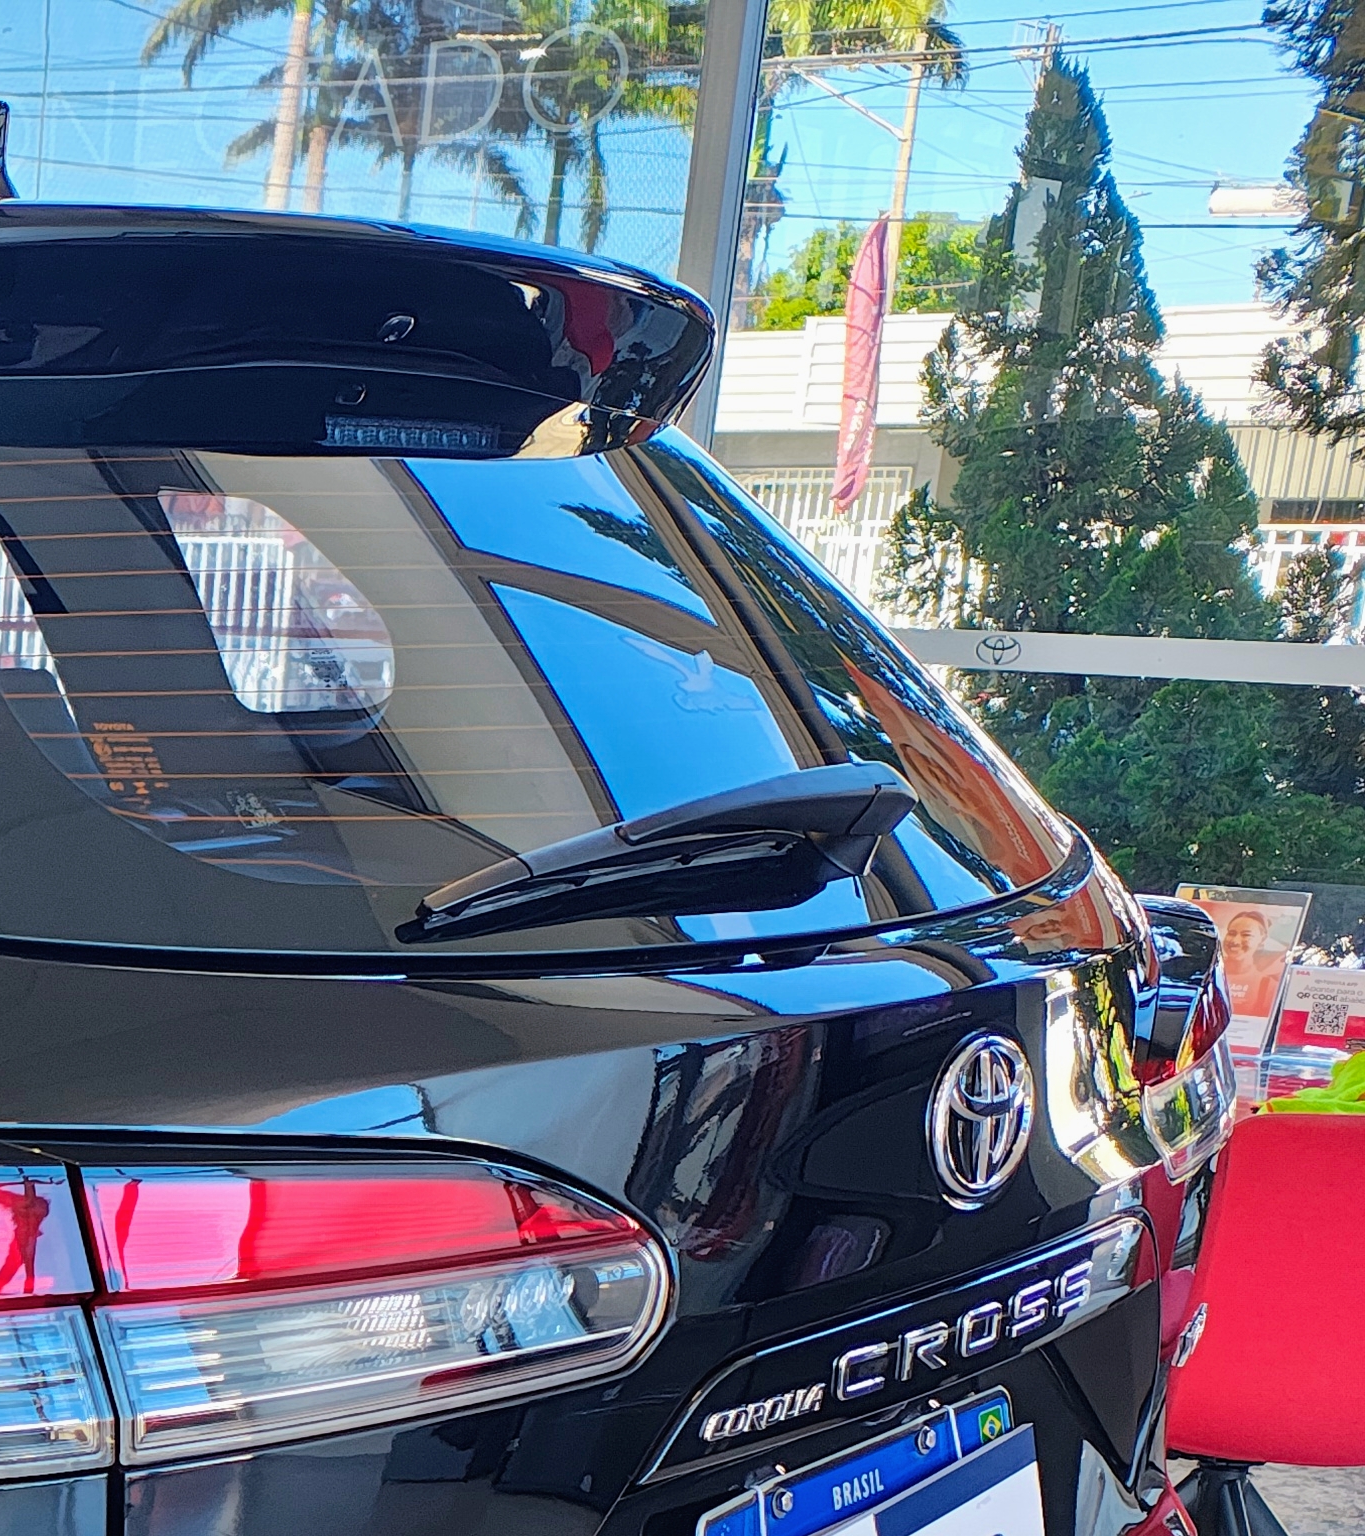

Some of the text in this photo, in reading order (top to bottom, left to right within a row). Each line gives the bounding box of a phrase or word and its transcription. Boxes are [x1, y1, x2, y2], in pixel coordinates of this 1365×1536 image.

[1296, 991, 1311, 999] QR
[1311, 993, 1338, 1001] CODE
[1336, 988, 1356, 996] para
[701, 1260, 1093, 1441] COROLLA CROSS
[831, 1468, 885, 1512] BRASIL
